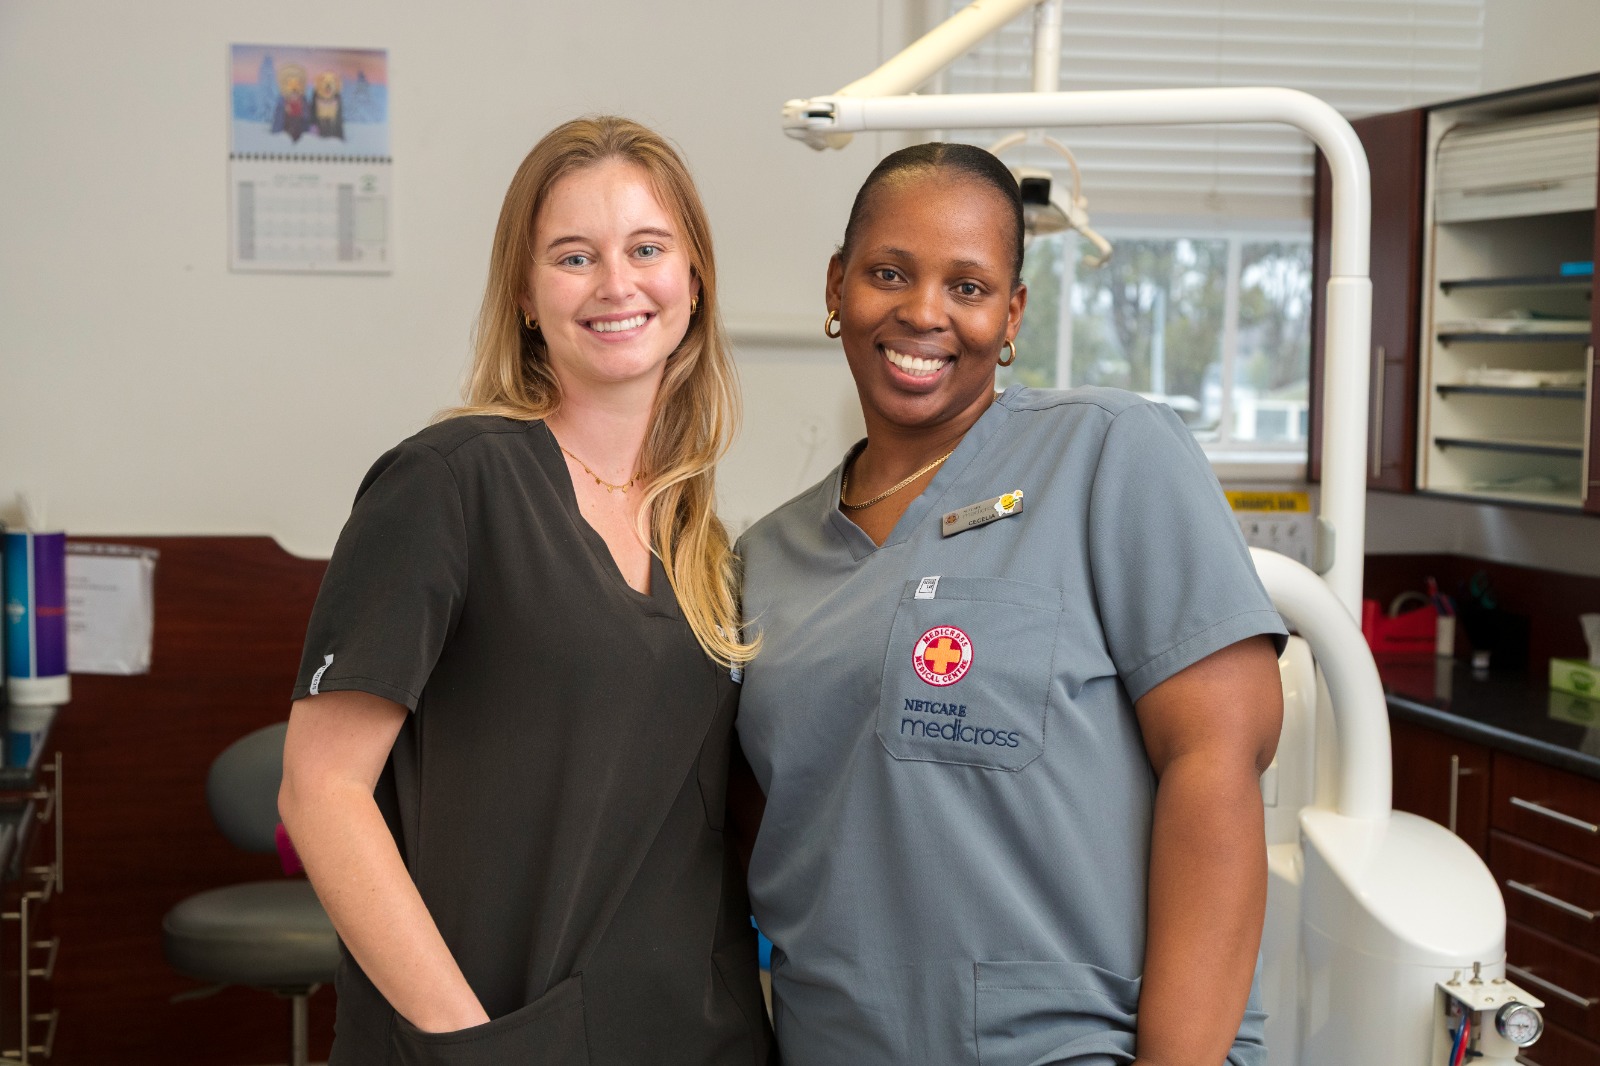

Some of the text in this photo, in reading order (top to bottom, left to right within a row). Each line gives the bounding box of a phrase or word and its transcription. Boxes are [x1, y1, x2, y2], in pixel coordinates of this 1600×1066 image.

[922, 628, 969, 647] MEDICROSS
[914, 655, 969, 683] MEDICAL CENTRE
[904, 698, 967, 717] NETCARE
[900, 718, 1020, 748] medicross
